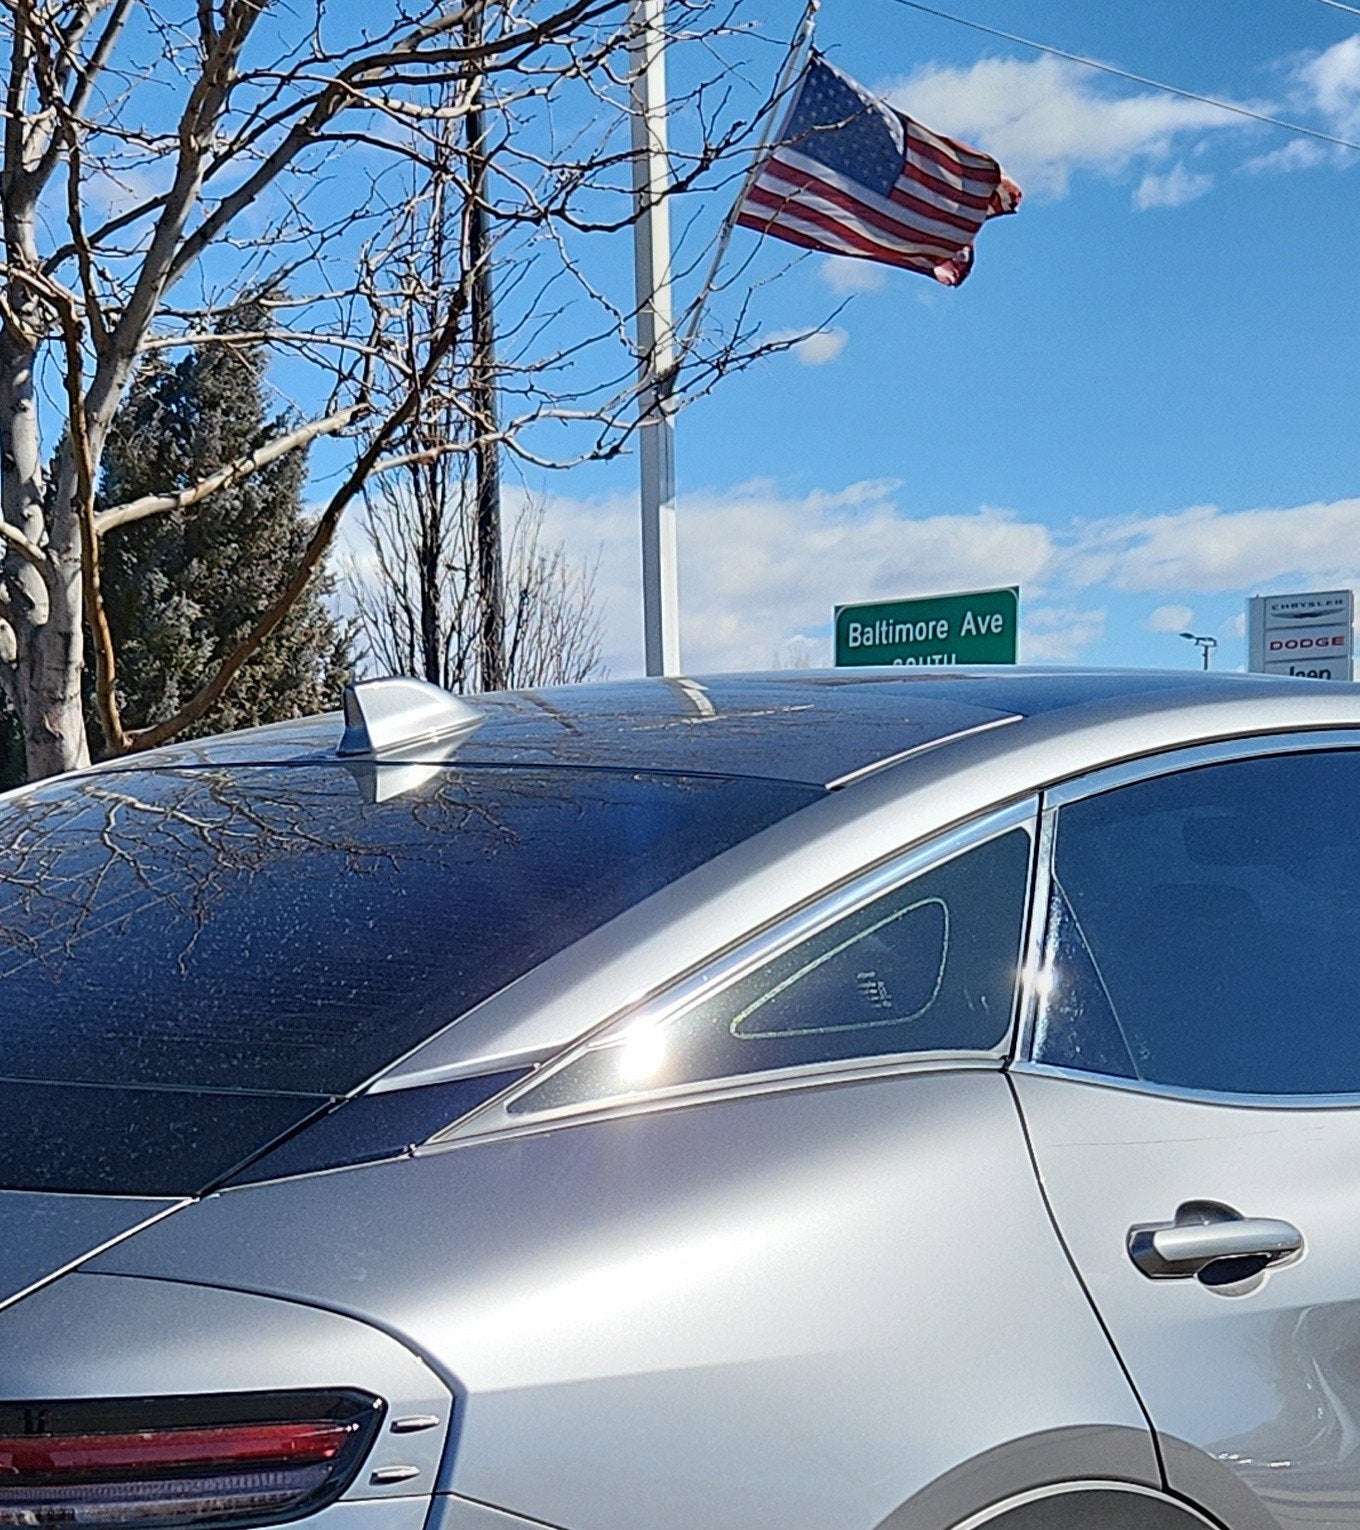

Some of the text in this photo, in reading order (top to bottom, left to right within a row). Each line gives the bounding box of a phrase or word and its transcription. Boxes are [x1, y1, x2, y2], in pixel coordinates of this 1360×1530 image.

[848, 610, 1003, 648] Baltimore Ave
[1269, 636, 1345, 651] DODGE
